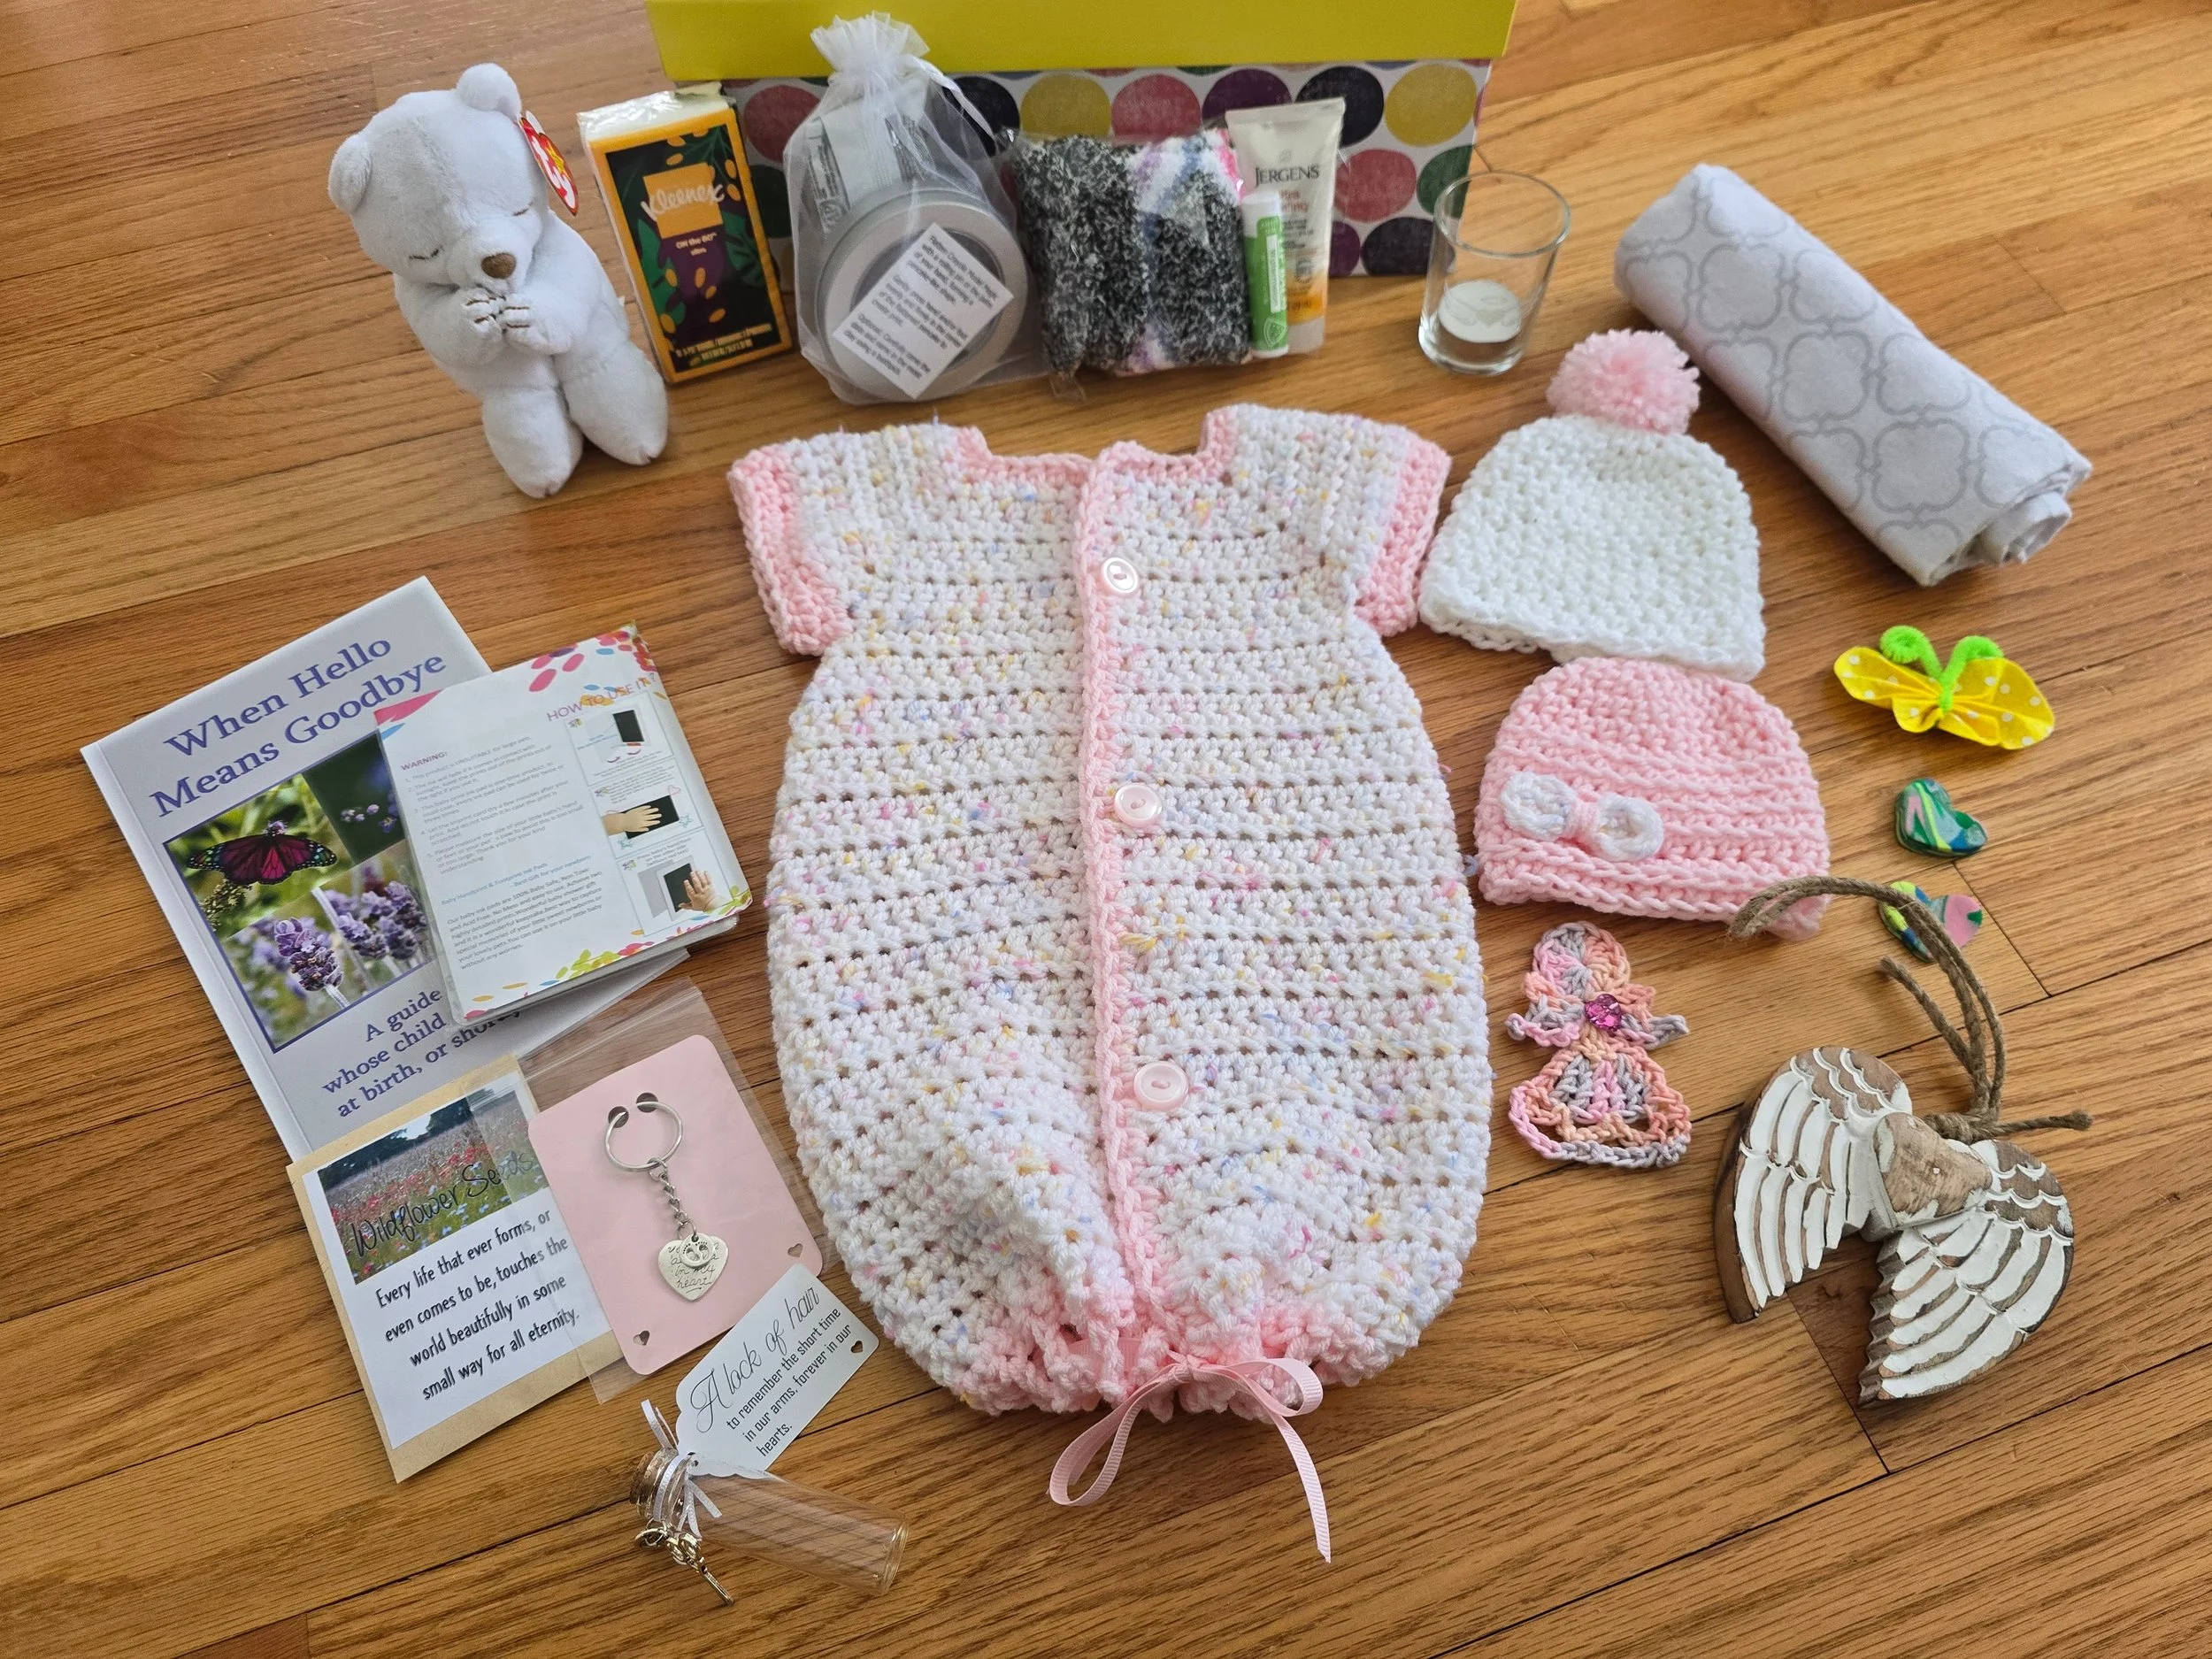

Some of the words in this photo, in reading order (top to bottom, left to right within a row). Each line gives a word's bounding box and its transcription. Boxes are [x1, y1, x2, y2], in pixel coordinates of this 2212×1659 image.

[639, 182, 726, 222] Kleenex
[1255, 165, 1321, 188] JERGENS
[149, 741, 280, 818] Means
[284, 656, 446, 744] Goodbye
[163, 694, 289, 757] When
[288, 638, 392, 698] Hello
[546, 701, 582, 722] HOW
[401, 750, 448, 771] WARNING:
[322, 1050, 391, 1094] whose
[394, 1013, 447, 1052] child
[365, 1024, 384, 1042] A
[386, 989, 443, 1031] guide
[337, 1097, 361, 1118] at
[359, 1064, 422, 1102] birth,
[425, 1044, 449, 1064] or
[352, 1184, 458, 1258] Wildflower
[461, 1152, 532, 1197] Seeds
[375, 1281, 411, 1309] Every
[412, 1265, 435, 1288] life
[437, 1252, 465, 1275] that
[467, 1239, 493, 1261] ever
[495, 1219, 537, 1247] forms,
[537, 1210, 551, 1225] or
[385, 1318, 415, 1342] even
[417, 1295, 457, 1325] comes
[457, 1286, 473, 1302] to
[474, 1275, 497, 1293] be,
[495, 1248, 545, 1283] touches
[546, 1235, 569, 1256] the
[409, 1332, 447, 1367] world
[446, 1299, 513, 1347] beautifully
[516, 1294, 531, 1310] in
[533, 1275, 567, 1302] some
[422, 1366, 457, 1401] small
[457, 1356, 484, 1380] way
[487, 1344, 505, 1364] for
[510, 1328, 526, 1352] all
[527, 1308, 580, 1343] eternity.
[690, 1367, 733, 1433] A
[723, 1341, 763, 1395] lock
[764, 1318, 787, 1356] of
[784, 1286, 820, 1330] hair
[726, 1417, 741, 1430] to
[738, 1369, 783, 1419] remember
[781, 1354, 799, 1371] the
[796, 1326, 823, 1356] short
[818, 1308, 841, 1331] time
[742, 1429, 757, 1442] in
[755, 1412, 770, 1432] our
[770, 1386, 799, 1415] arms,
[792, 1350, 827, 1388] forever
[825, 1341, 838, 1355] in
[836, 1324, 852, 1344] our
[756, 1422, 794, 1456] hearts.
